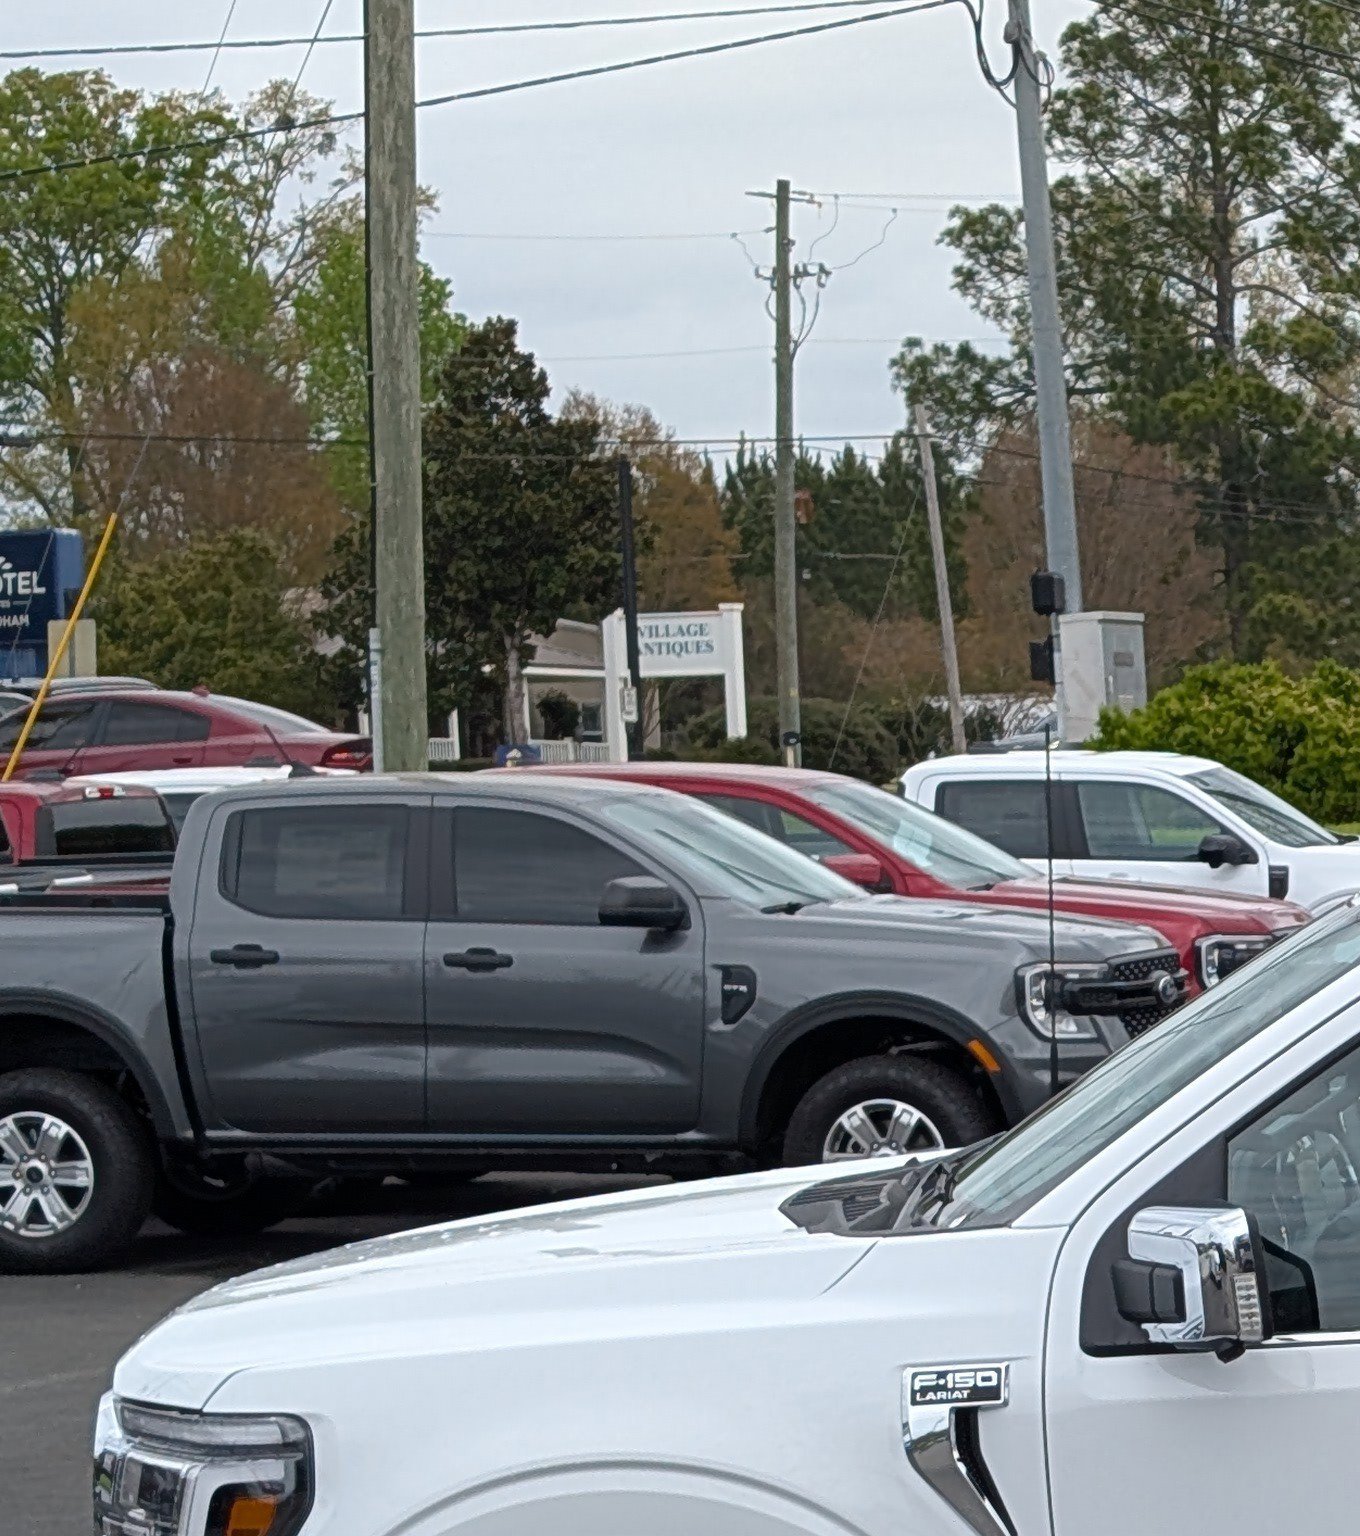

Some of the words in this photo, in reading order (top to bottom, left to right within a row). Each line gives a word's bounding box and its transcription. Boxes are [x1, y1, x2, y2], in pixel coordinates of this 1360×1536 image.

[0, 570, 46, 596] TEL
[0, 614, 30, 627] HAM
[638, 622, 709, 639] VILLAGE
[915, 1389, 971, 1402] LARIAT
